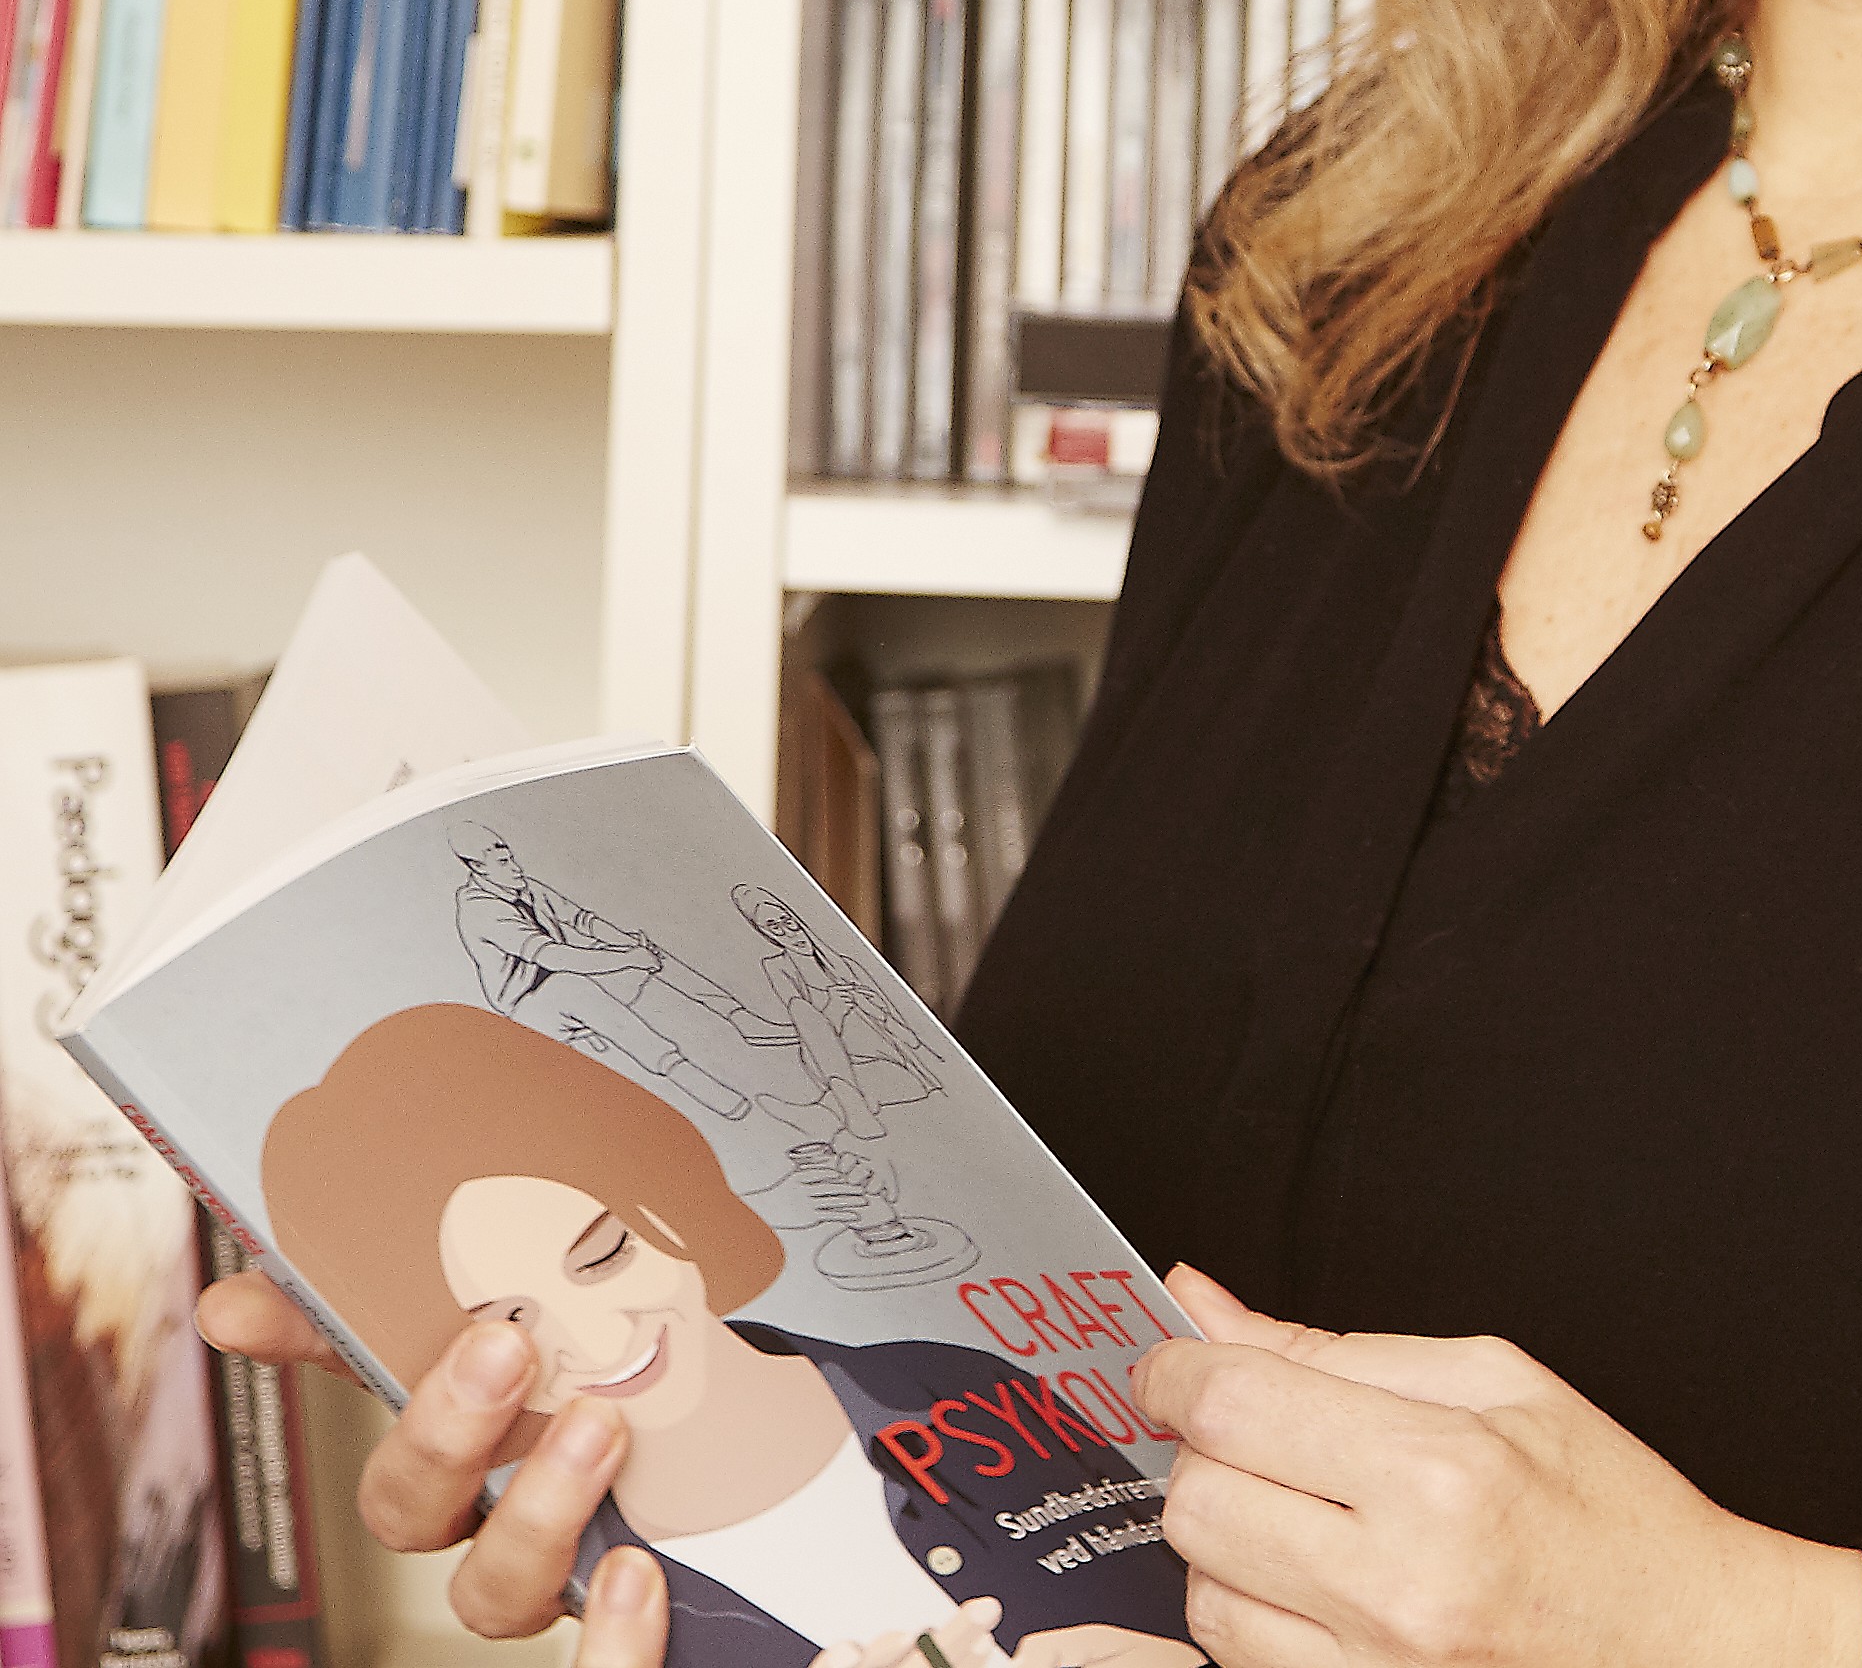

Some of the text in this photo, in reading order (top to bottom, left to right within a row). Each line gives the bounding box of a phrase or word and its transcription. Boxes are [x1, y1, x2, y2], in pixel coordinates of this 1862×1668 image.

[957, 1268, 1174, 1358] CRAFT
[874, 1365, 1179, 1504] PSYKOL
[1036, 1531, 1093, 1575] ved
